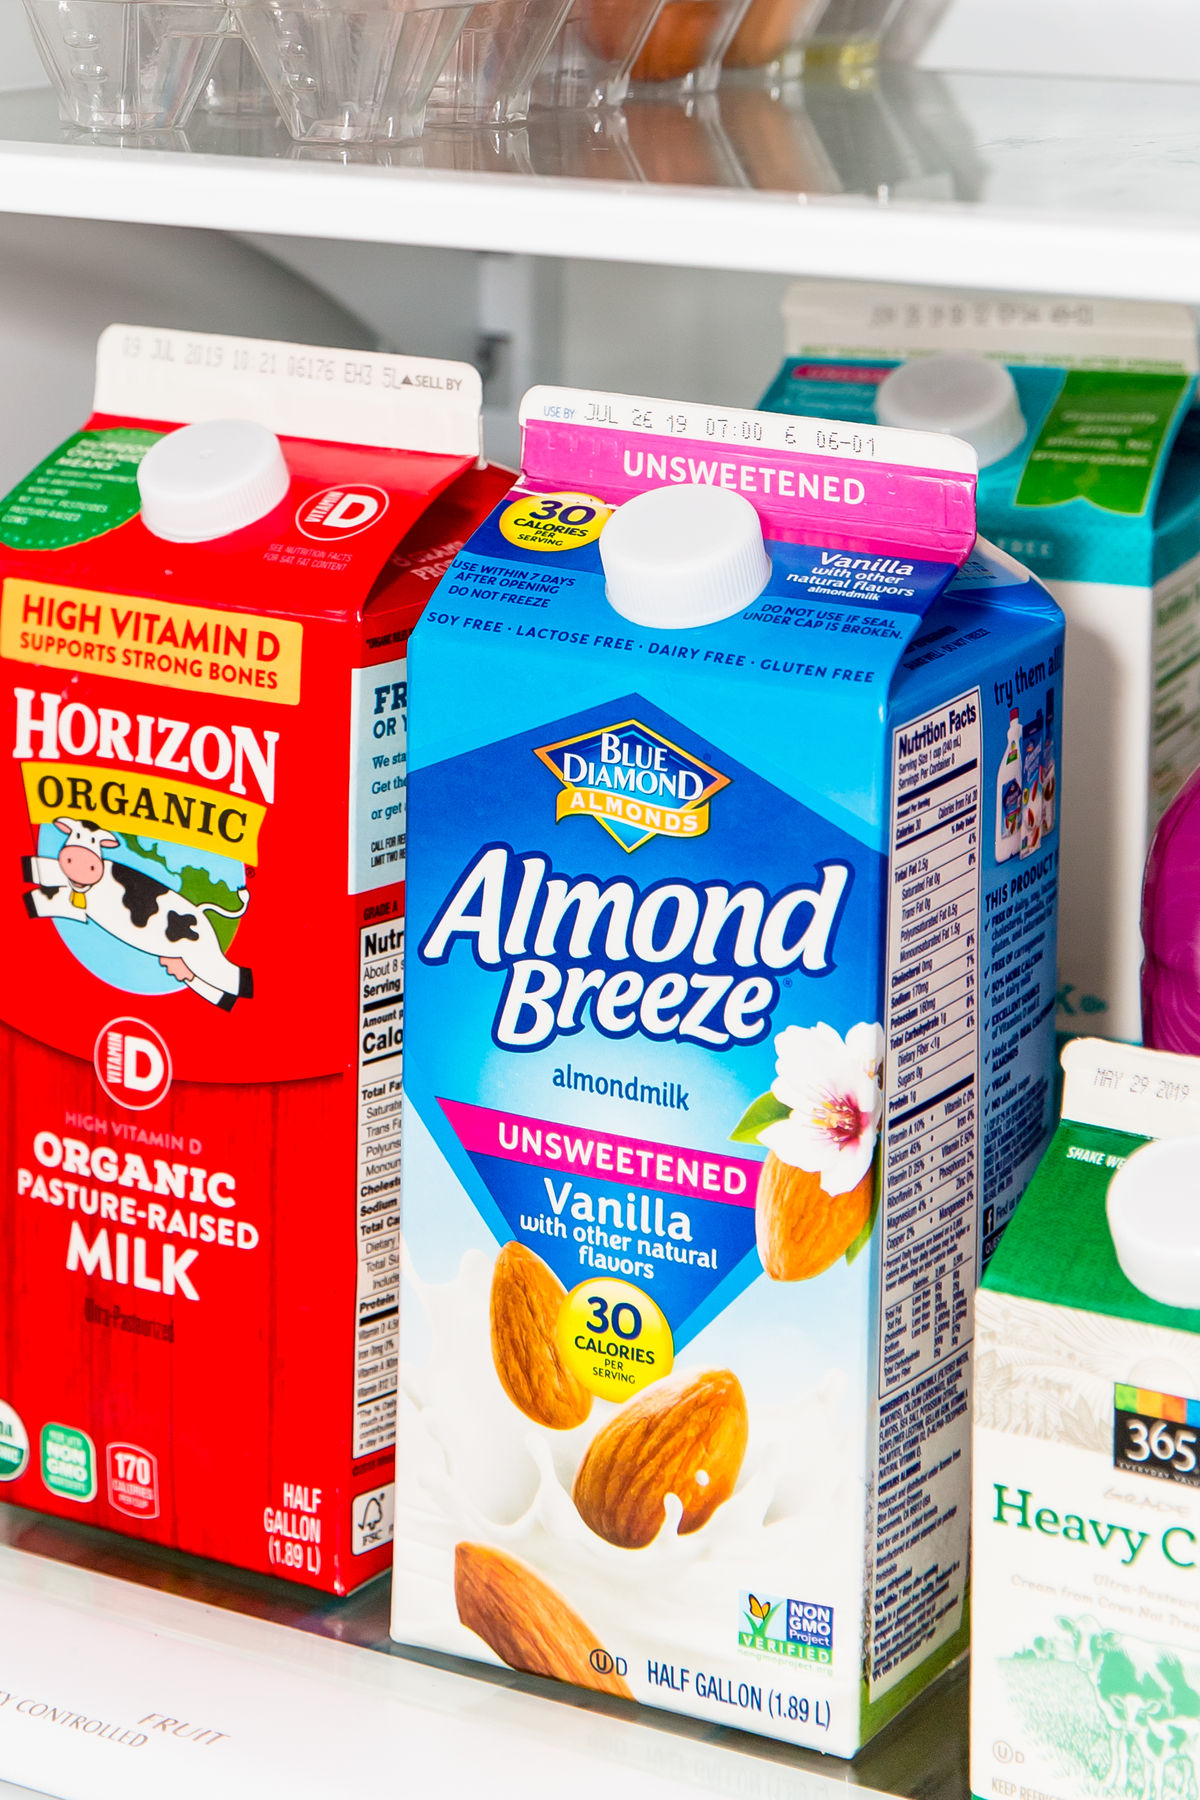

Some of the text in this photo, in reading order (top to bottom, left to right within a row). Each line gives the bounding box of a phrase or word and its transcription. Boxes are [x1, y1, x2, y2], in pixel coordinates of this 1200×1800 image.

[414, 374, 464, 392] SELL BY
[544, 405, 575, 420] USE BY
[584, 403, 618, 425] JUL
[623, 450, 866, 507] UNSWEETENED
[304, 491, 379, 528] VITAMIN D
[529, 499, 596, 526] 30
[513, 517, 589, 538] CALORIES
[517, 533, 564, 547] SERVING
[533, 529, 556, 540] PER
[451, 558, 577, 587] USE WITHIN 7 DAYS
[811, 564, 905, 586] with other
[820, 550, 915, 577] Vanilla
[448, 585, 552, 609] DO NOT FREEZE
[454, 571, 561, 595] AFTER OPENING
[785, 571, 916, 598] natural flavors
[806, 584, 881, 602] almondmilk
[21, 594, 281, 662] HIGH VITAMIN D
[742, 611, 904, 640] UNDER CAP IS BROKEN.
[760, 603, 896, 629] DO NOT USE IF SEAL
[19, 631, 279, 690] SUPPORTS STRONG BONES
[426, 611, 876, 684] SOY FREE LACTOSE FREE DAIRY FREE GLUTEN FREE
[993, 662, 1047, 709] try them
[12, 687, 280, 805] HORIZON
[898, 702, 977, 761] Nutrition Facts
[600, 732, 669, 773] BLUE
[562, 752, 705, 803] DIAMOND
[37, 775, 248, 844] ORGANIC
[569, 790, 700, 833] ALMONDS
[423, 847, 848, 971] Almond
[363, 977, 401, 999] Serving
[497, 958, 774, 1047] Breeze
[106, 1031, 165, 1092] VITAMIN D
[552, 1063, 690, 1112] almondmilk
[1093, 1066, 1191, 1101] MAY 29 2019
[65, 1111, 203, 1155] HIGH VITAMIN D
[32, 1130, 237, 1209] ORGANIC
[497, 1120, 748, 1196] UNSWEETENED
[1066, 1145, 1105, 1166] SHAKE
[17, 1168, 260, 1250] PASTURE-RAISED
[360, 1196, 398, 1217] Sodium
[543, 1177, 694, 1243] Vanilla
[519, 1212, 719, 1271] with other natural
[65, 1220, 201, 1302] MILK
[578, 1244, 656, 1280] flavors
[359, 1292, 395, 1313] Protein
[584, 1295, 643, 1341] 30
[573, 1335, 656, 1367] CALORIES
[603, 1358, 625, 1372] PER
[591, 1366, 637, 1386] SERVING
[46, 1439, 87, 1466] NON
[1125, 1418, 1198, 1473] 365
[46, 1457, 88, 1483] GMO
[114, 1451, 151, 1486] 170
[283, 1482, 322, 1514] HALF
[263, 1507, 321, 1544] GALLON
[993, 1482, 1150, 1566] Heavy
[268, 1534, 322, 1576] (1.89 L)
[788, 1617, 832, 1637] GMO
[789, 1601, 831, 1623] NON
[742, 1633, 831, 1664] VERIFIED
[788, 1629, 831, 1648] Project
[647, 1659, 832, 1731] HALF GALLON (1.89 L)
[15, 1698, 149, 1749] CONTROLLED
[136, 1711, 231, 1747] FRUIT
